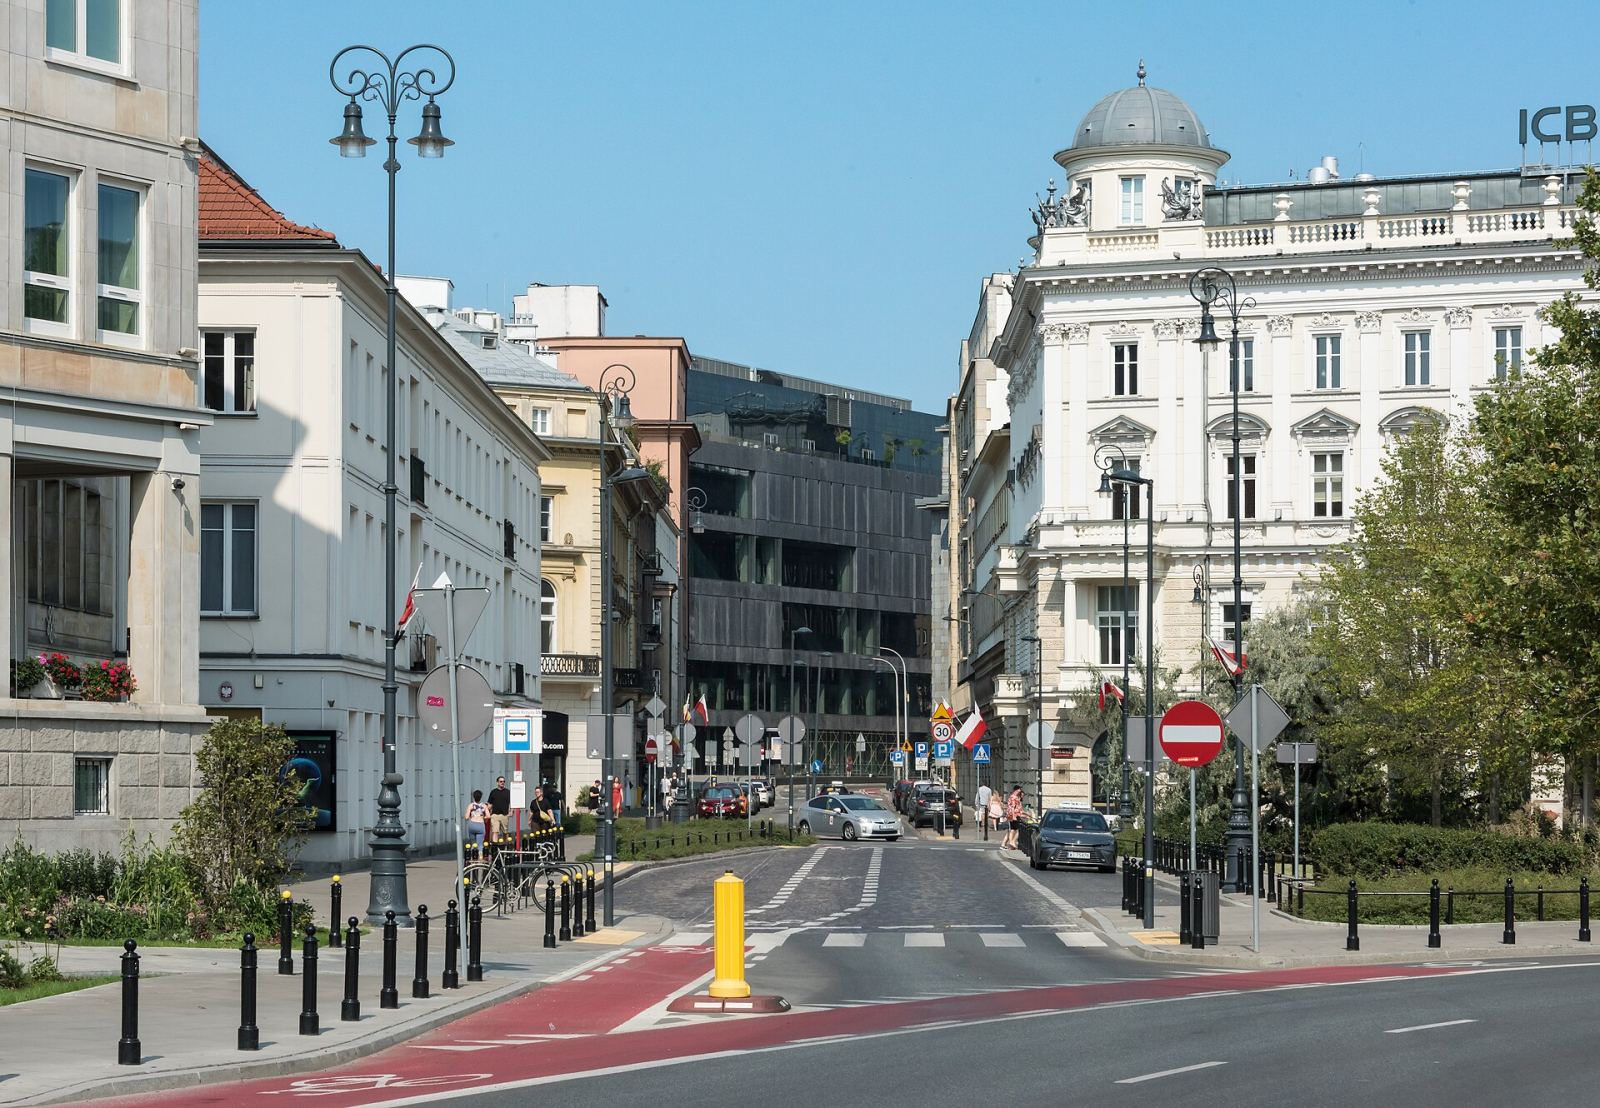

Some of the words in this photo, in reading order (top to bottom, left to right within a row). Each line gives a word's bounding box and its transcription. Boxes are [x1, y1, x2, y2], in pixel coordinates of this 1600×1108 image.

[1519, 105, 1598, 144] ICB
[936, 728, 949, 737] 30
[918, 744, 925, 753] P
[938, 744, 948, 756] P
